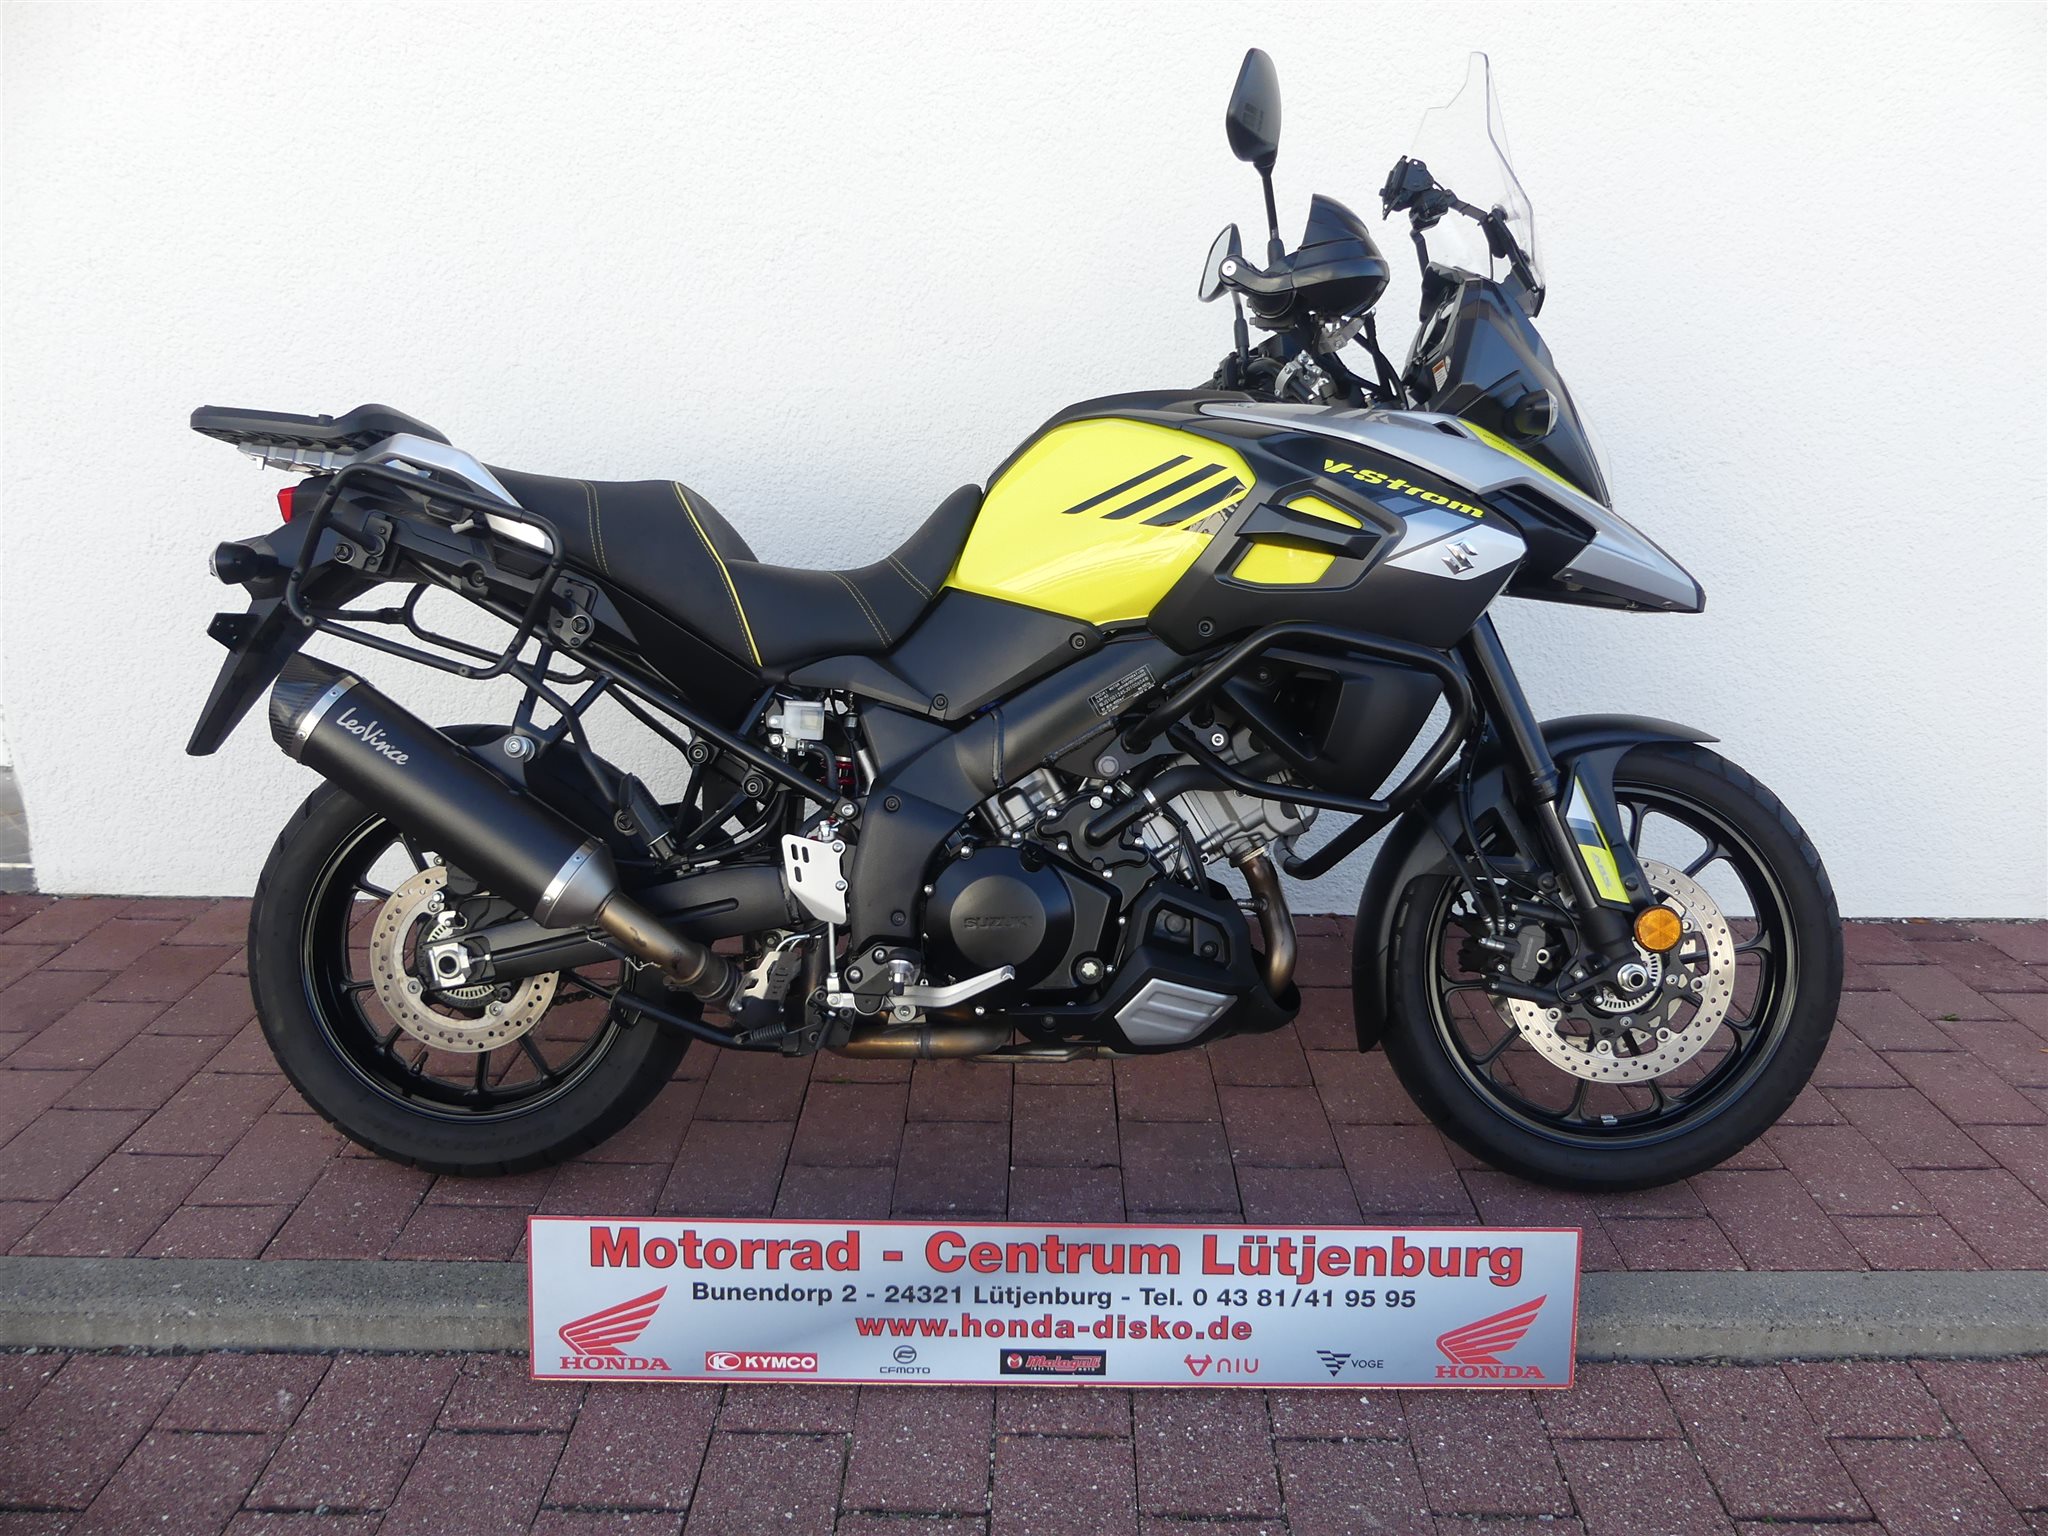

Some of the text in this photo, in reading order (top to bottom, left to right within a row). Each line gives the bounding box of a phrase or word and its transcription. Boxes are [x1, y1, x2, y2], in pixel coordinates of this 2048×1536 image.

[1323, 458, 1486, 518] V-Strom
[336, 707, 409, 765] LeoVince
[589, 1226, 860, 1271] Motorrad
[924, 1231, 1181, 1275] Centrum
[1201, 1233, 1524, 1287] Lütjenburg
[692, 1281, 833, 1306] Bunendorp
[841, 1285, 858, 1303] 2
[884, 1285, 962, 1304] 24321
[973, 1286, 1112, 1310] Lütjenburg
[1139, 1287, 1183, 1307] Tel.
[1192, 1288, 1208, 1307] 0
[1216, 1288, 1248, 1307] 43
[1256, 1288, 1333, 1308] 81/41
[1344, 1289, 1376, 1308] 95
[1385, 1289, 1416, 1309] 95
[854, 1313, 1253, 1341] www.honda-disko.de
[559, 1355, 672, 1371] HONDA
[745, 1355, 816, 1370] KYMCO
[879, 1366, 931, 1374] CFMOTO
[1350, 1359, 1384, 1369] VOGE
[1435, 1364, 1545, 1379] HONDA
